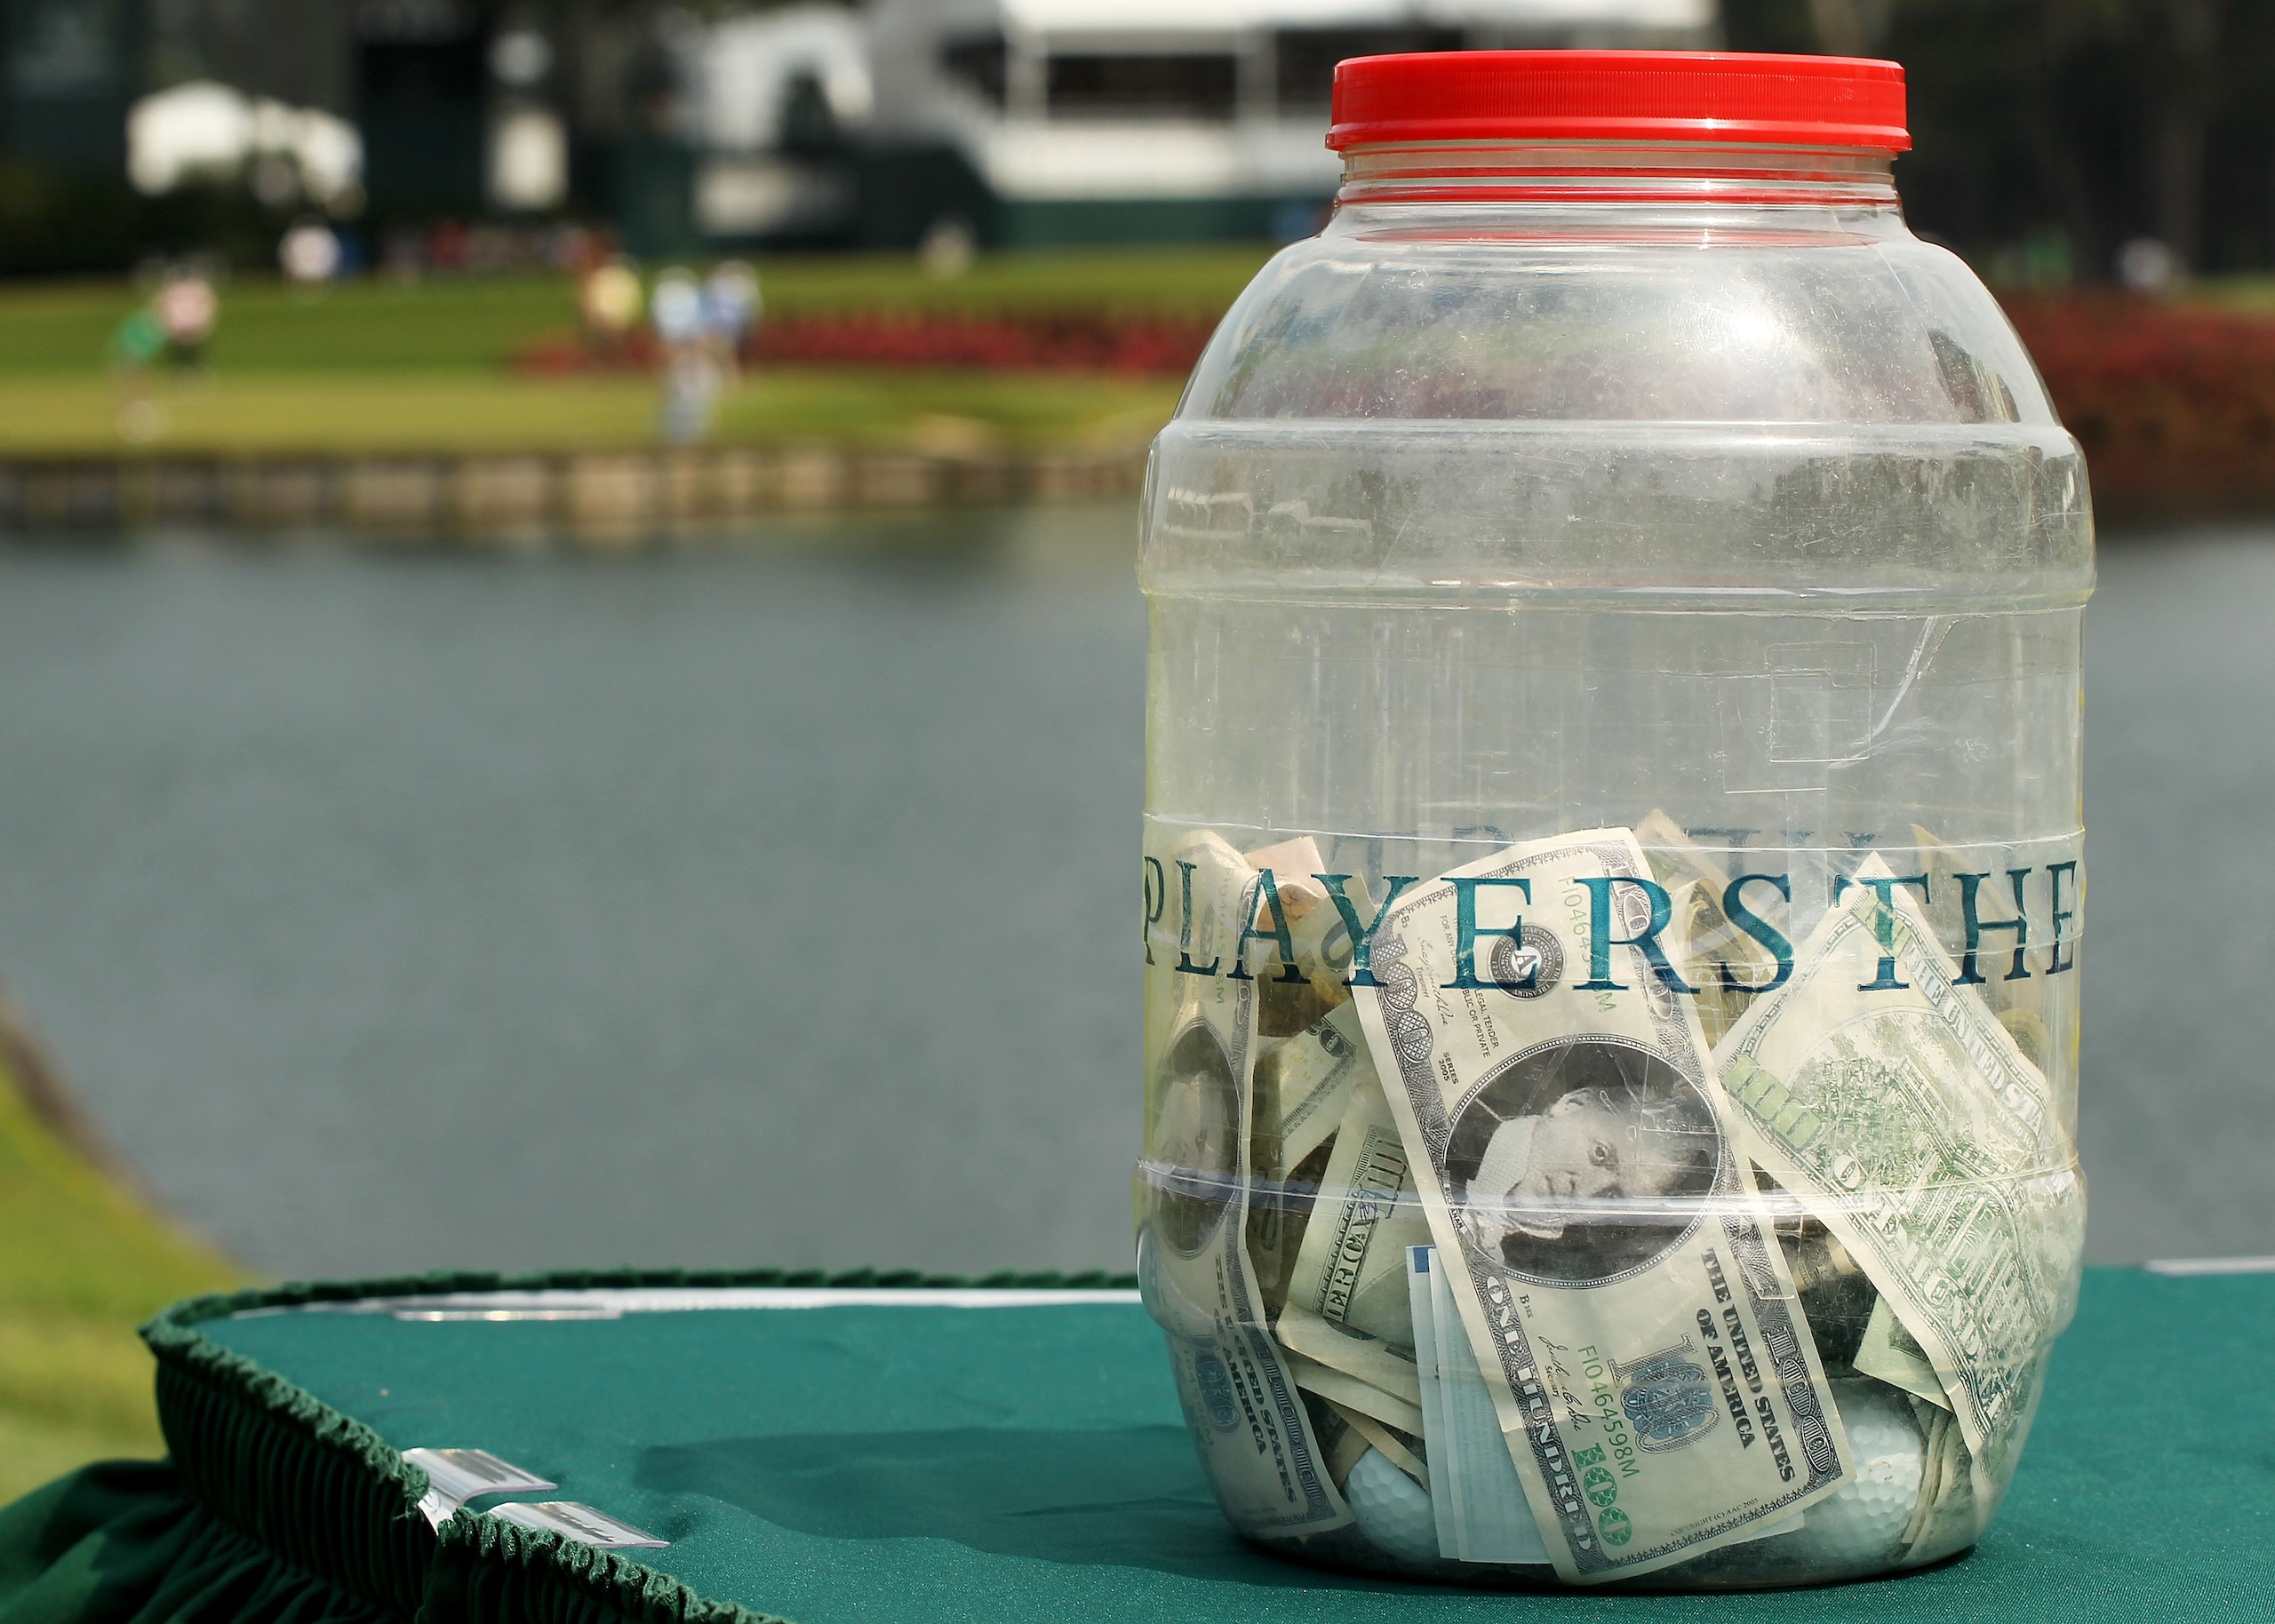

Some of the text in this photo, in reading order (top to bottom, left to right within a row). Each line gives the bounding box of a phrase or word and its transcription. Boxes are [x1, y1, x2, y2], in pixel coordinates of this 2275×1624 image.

[1144, 856, 2078, 994] PLAYERS THE
[1440, 914, 1449, 930] FOR
[1444, 931, 1455, 948] ANY
[1513, 951, 1537, 971] A
[1469, 1008, 1478, 1022] OR
[1482, 1014, 1499, 1049] TENDER
[1473, 1023, 1490, 1058] PRIVATE
[1437, 1058, 1450, 1082] 2005
[1442, 1051, 1458, 1085] SERIES
[1695, 1307, 1757, 1450] OF AMERICA
[1699, 1246, 1796, 1484] THE UNITED STATES
[1487, 1275, 1595, 1553] ONE HUNDRED
[1764, 1326, 1832, 1473] 100
[1259, 1407, 1297, 1505] STATES
[1571, 1445, 1633, 1547] 100
